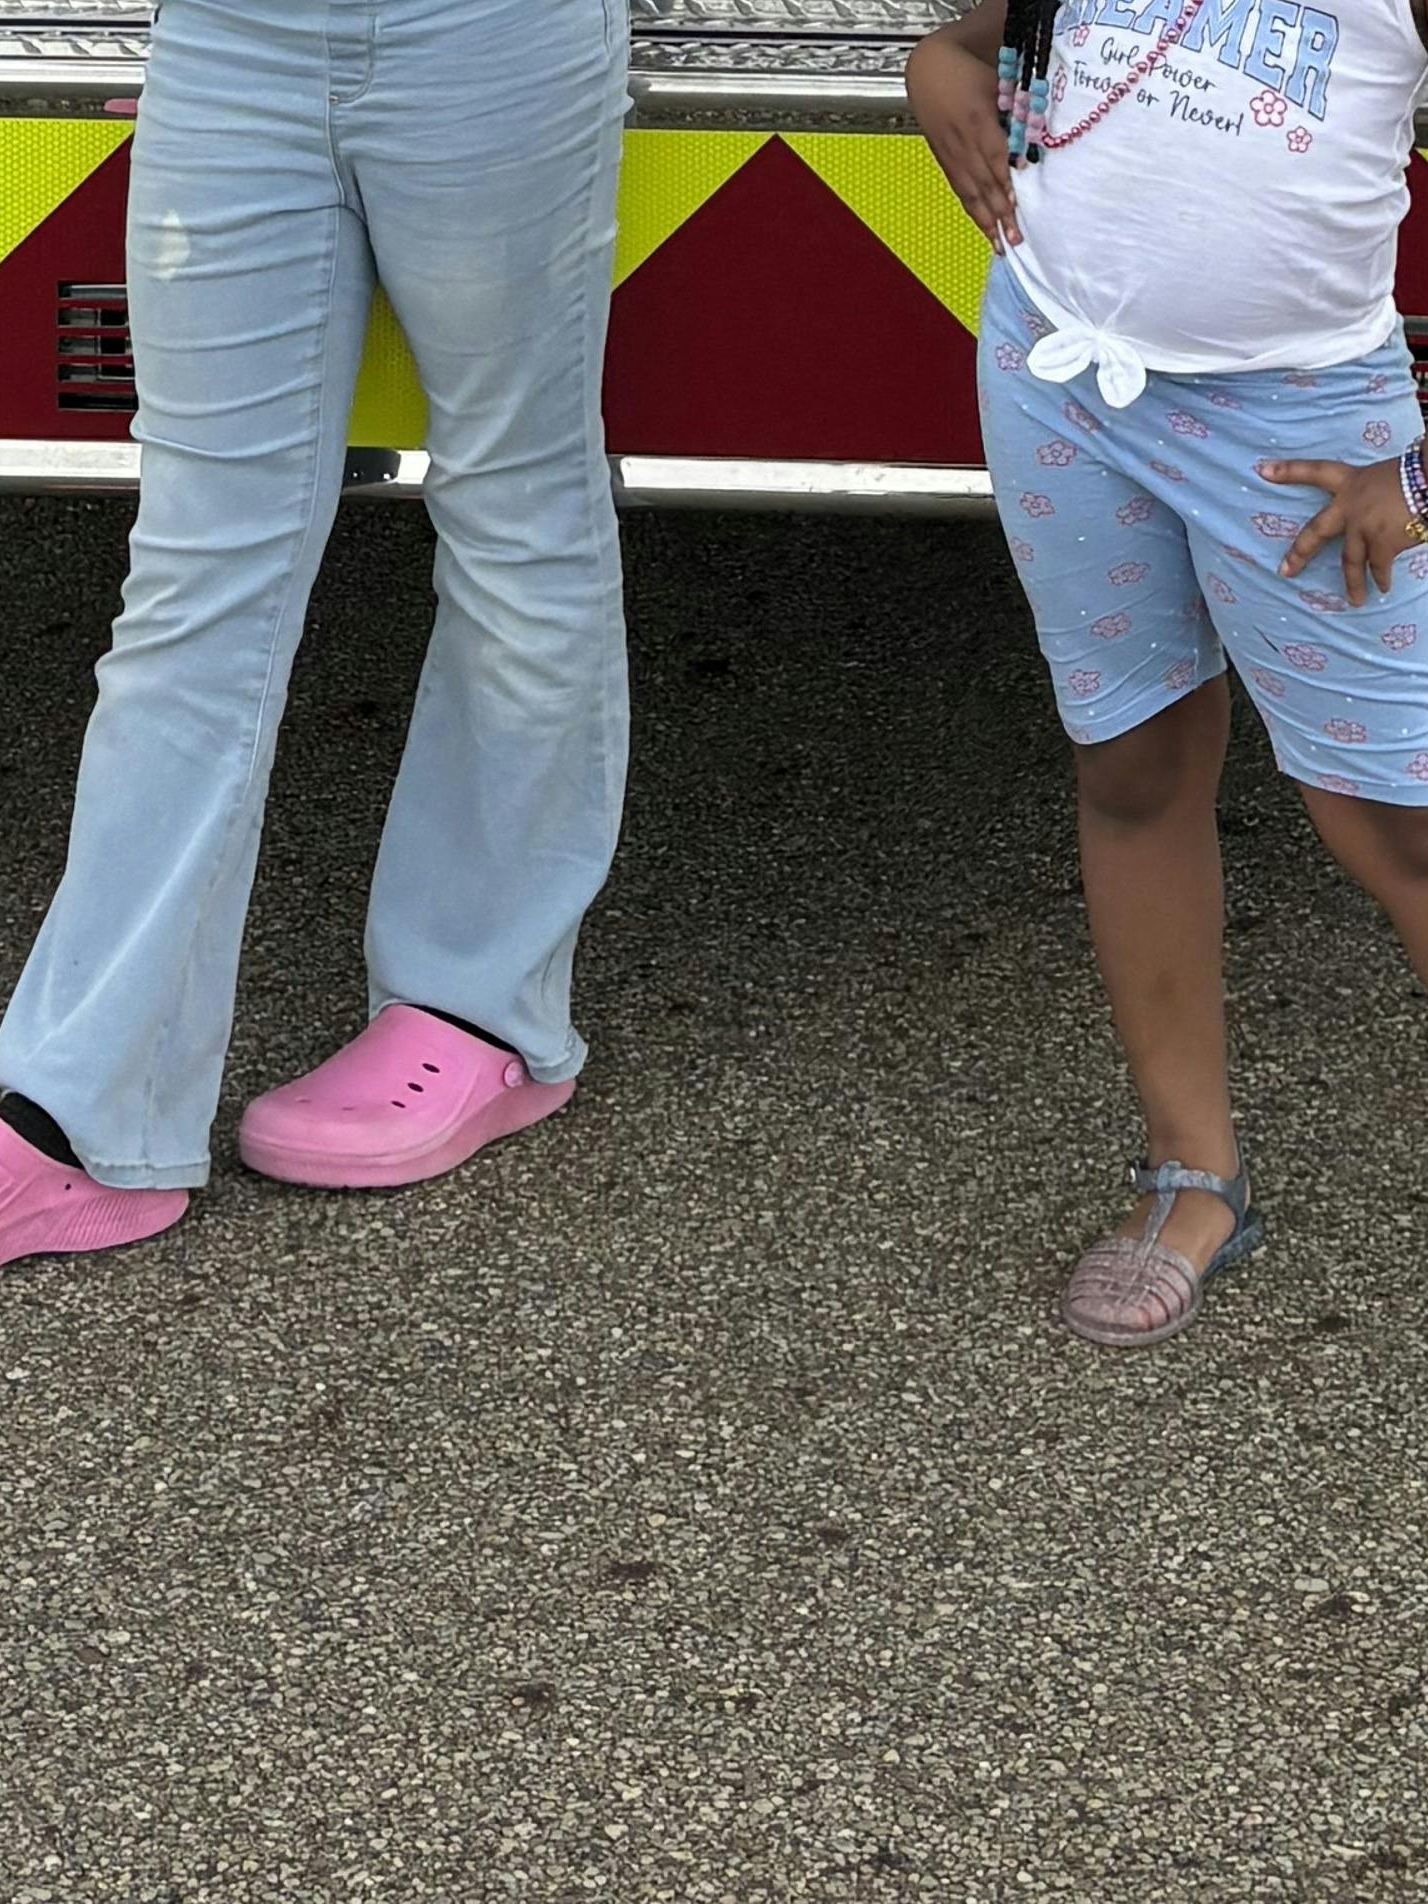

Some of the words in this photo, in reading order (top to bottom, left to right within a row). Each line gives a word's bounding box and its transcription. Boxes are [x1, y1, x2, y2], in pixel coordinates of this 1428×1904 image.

[1100, 36, 1140, 70] Girl
[1147, 52, 1217, 92] Power
[1136, 88, 1160, 107] or
